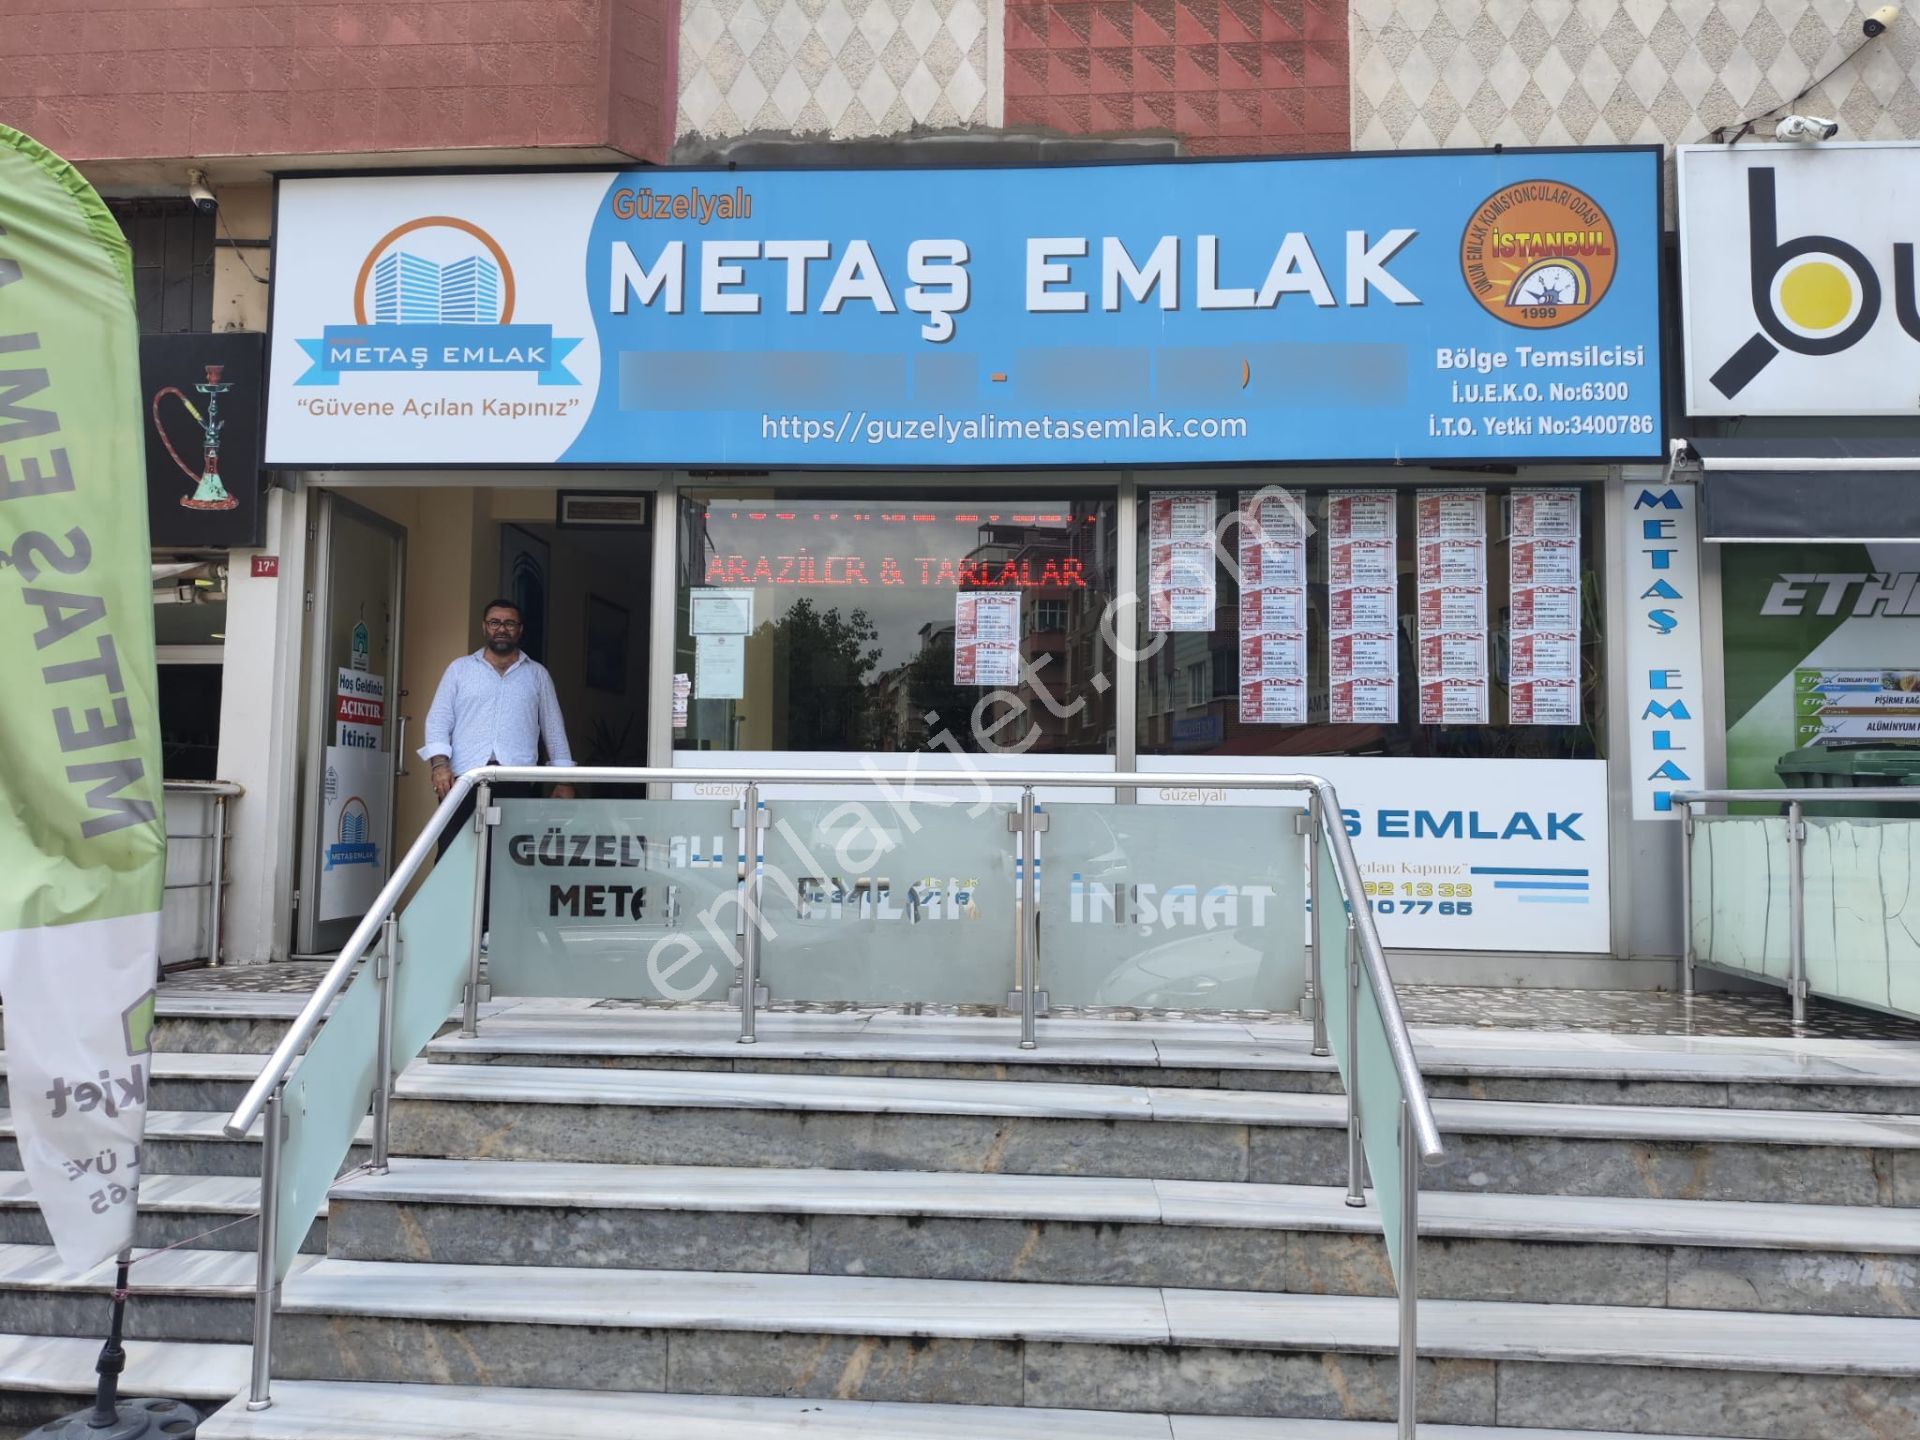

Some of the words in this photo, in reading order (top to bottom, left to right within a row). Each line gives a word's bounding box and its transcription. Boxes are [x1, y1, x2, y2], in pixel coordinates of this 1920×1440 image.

[612, 187, 752, 224] Güzelyalı
[1467, 225, 1489, 261] EMLAK
[1569, 196, 1602, 227] ODASI
[1491, 226, 1611, 258] İSTANBUL
[609, 239, 971, 343] METAŞ
[1026, 228, 1425, 313] EMLAK
[1521, 307, 1557, 319] 1999
[330, 346, 428, 368] METAŞ
[443, 346, 546, 364] EMLAK
[1437, 347, 1508, 373] Bölge
[1515, 345, 1645, 368] Temsilcisi
[1452, 380, 1543, 403] İ.U.E.K.O.
[1550, 382, 1629, 402] No:6300
[403, 398, 474, 419] Açılan
[761, 411, 1247, 444] https//guzelyalimetasemlak.com
[1429, 414, 1477, 436] İ.T.O.
[1483, 416, 1533, 436] Yetki
[1538, 415, 1653, 436] No:3400786
[1633, 489, 1684, 634] METAŞ
[339, 674, 354, 695] Hoş
[355, 677, 383, 696] Geldiniz
[340, 700, 381, 719] AÇIKTIR
[342, 724, 376, 749] İtiniz
[1867, 720, 1916, 731] ALÜMİNYUM
[1377, 809, 1585, 841] EMLAK
[1400, 881, 1433, 897] 13
[1438, 883, 1473, 898] 33
[1070, 872, 1277, 936] İNŞAAT
[1400, 901, 1433, 915] 77
[1438, 901, 1473, 915] 65
